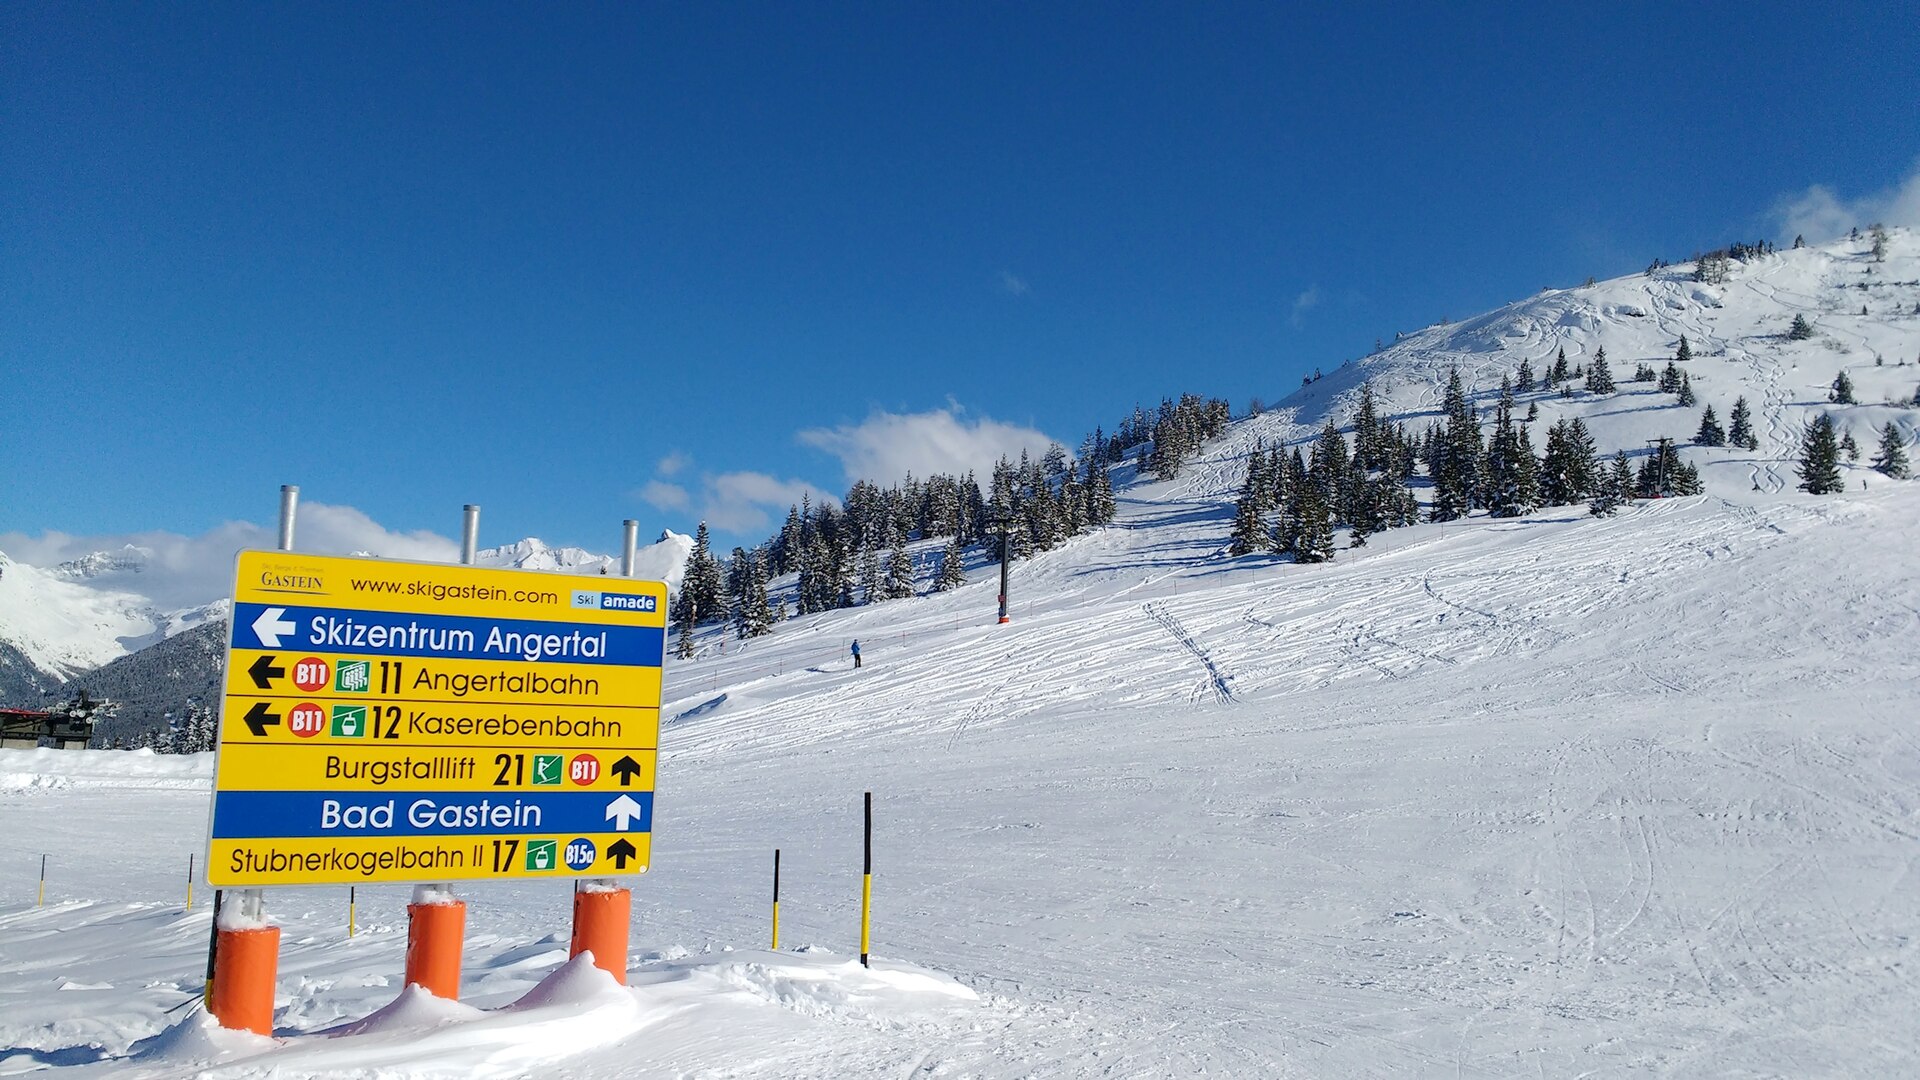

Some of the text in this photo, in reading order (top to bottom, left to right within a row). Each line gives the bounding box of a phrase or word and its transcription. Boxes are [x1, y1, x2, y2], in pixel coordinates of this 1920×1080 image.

[261, 571, 323, 589] GASTEIN
[351, 578, 558, 604] www.skigastein.com
[577, 594, 594, 605] Ski
[309, 615, 607, 661] Skizentrum Angertal
[296, 661, 599, 697] B11 11 Angertalbahn
[292, 706, 622, 739] B11 12 Kaserebenbahn
[325, 753, 597, 786] Burgstalllift 21 B11
[321, 799, 542, 829] Bad Gastein
[230, 845, 464, 876] Stubnerkogelbahn
[493, 840, 519, 872] 17
[566, 844, 594, 864] B15a
